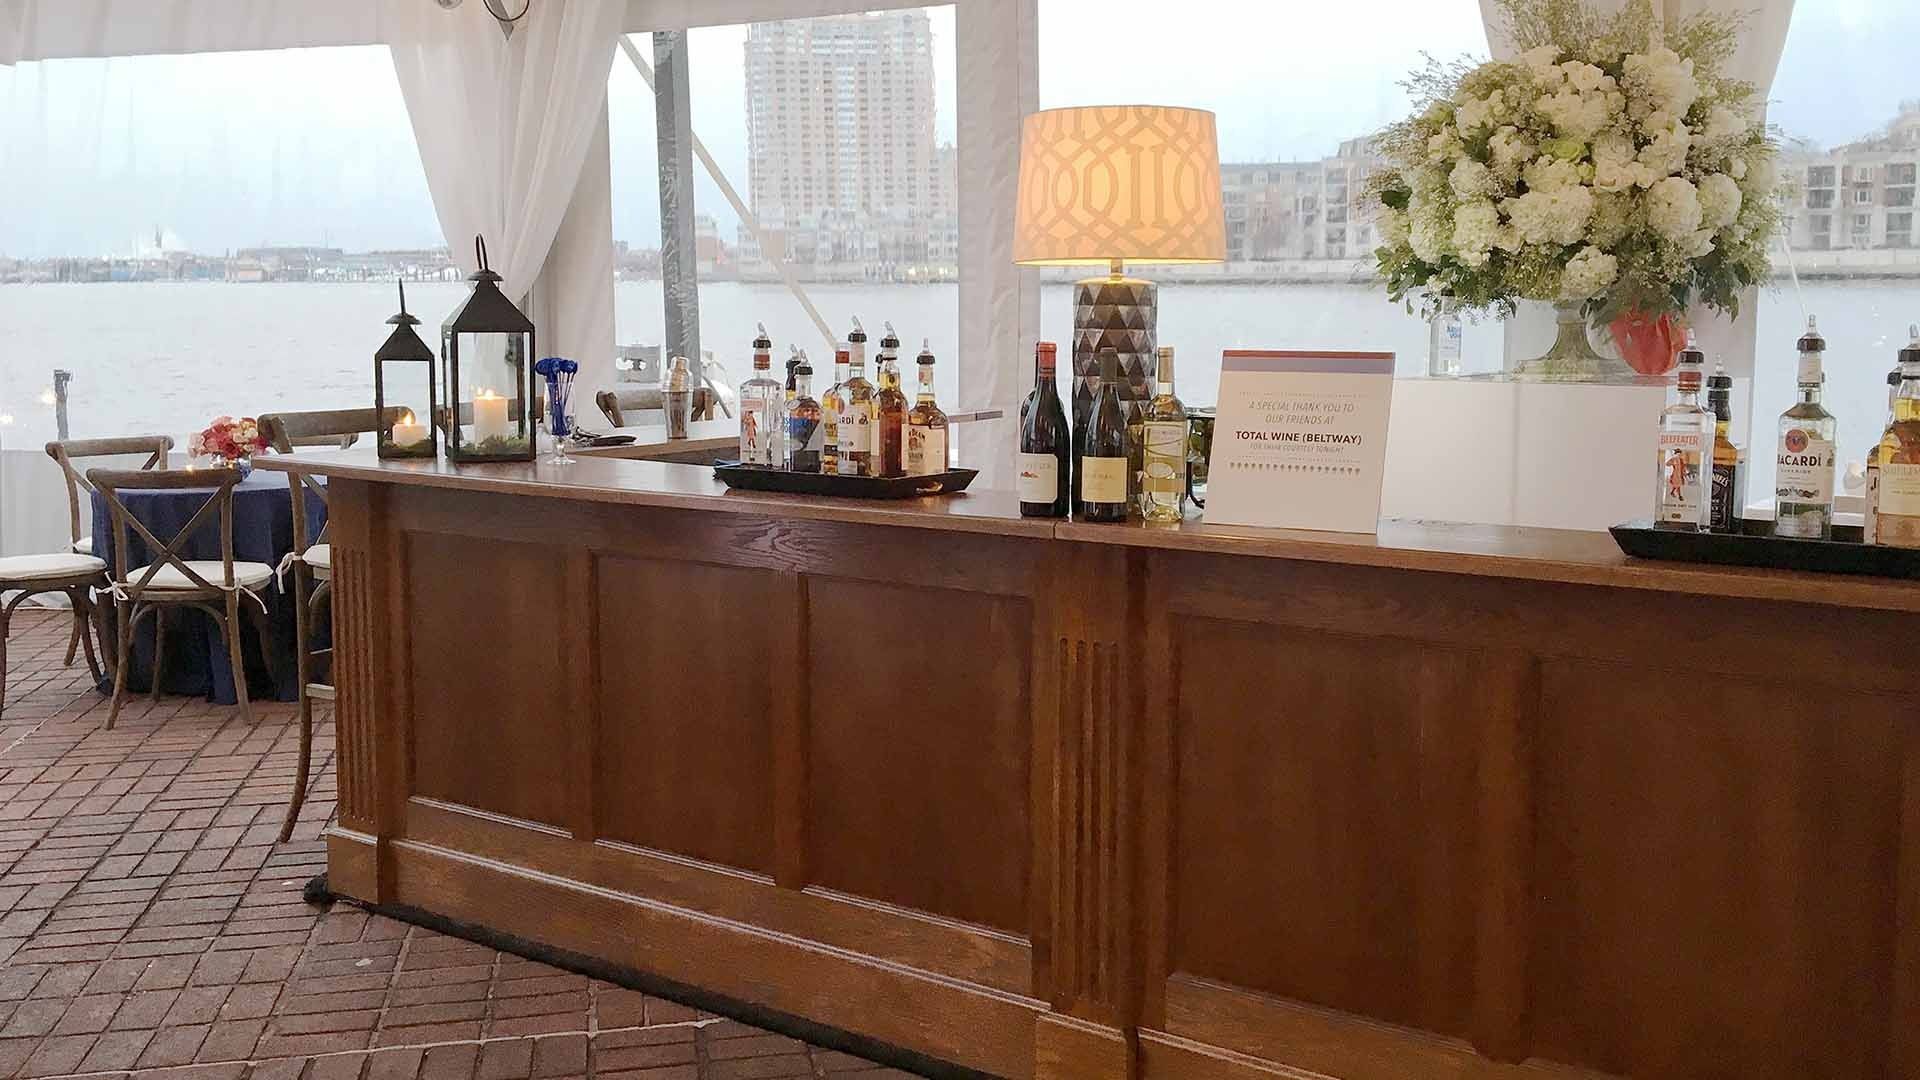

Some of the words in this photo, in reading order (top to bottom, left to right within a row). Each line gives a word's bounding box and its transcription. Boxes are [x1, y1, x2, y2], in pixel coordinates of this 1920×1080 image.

[1248, 401, 1255, 409] A
[1257, 401, 1290, 411] SPECIAL
[1292, 402, 1320, 412] THANK
[1322, 403, 1341, 413] YOU
[1343, 404, 1355, 413] TO
[1265, 414, 1285, 424] OUR
[1286, 415, 1322, 425] FRIENDS
[1323, 415, 1335, 425] AT
[1235, 430, 1269, 441] TOTAL
[1271, 432, 1300, 442] WINE
[1302, 433, 1362, 446] (BELTWAY)
[1660, 434, 1698, 446] BEEFEATER
